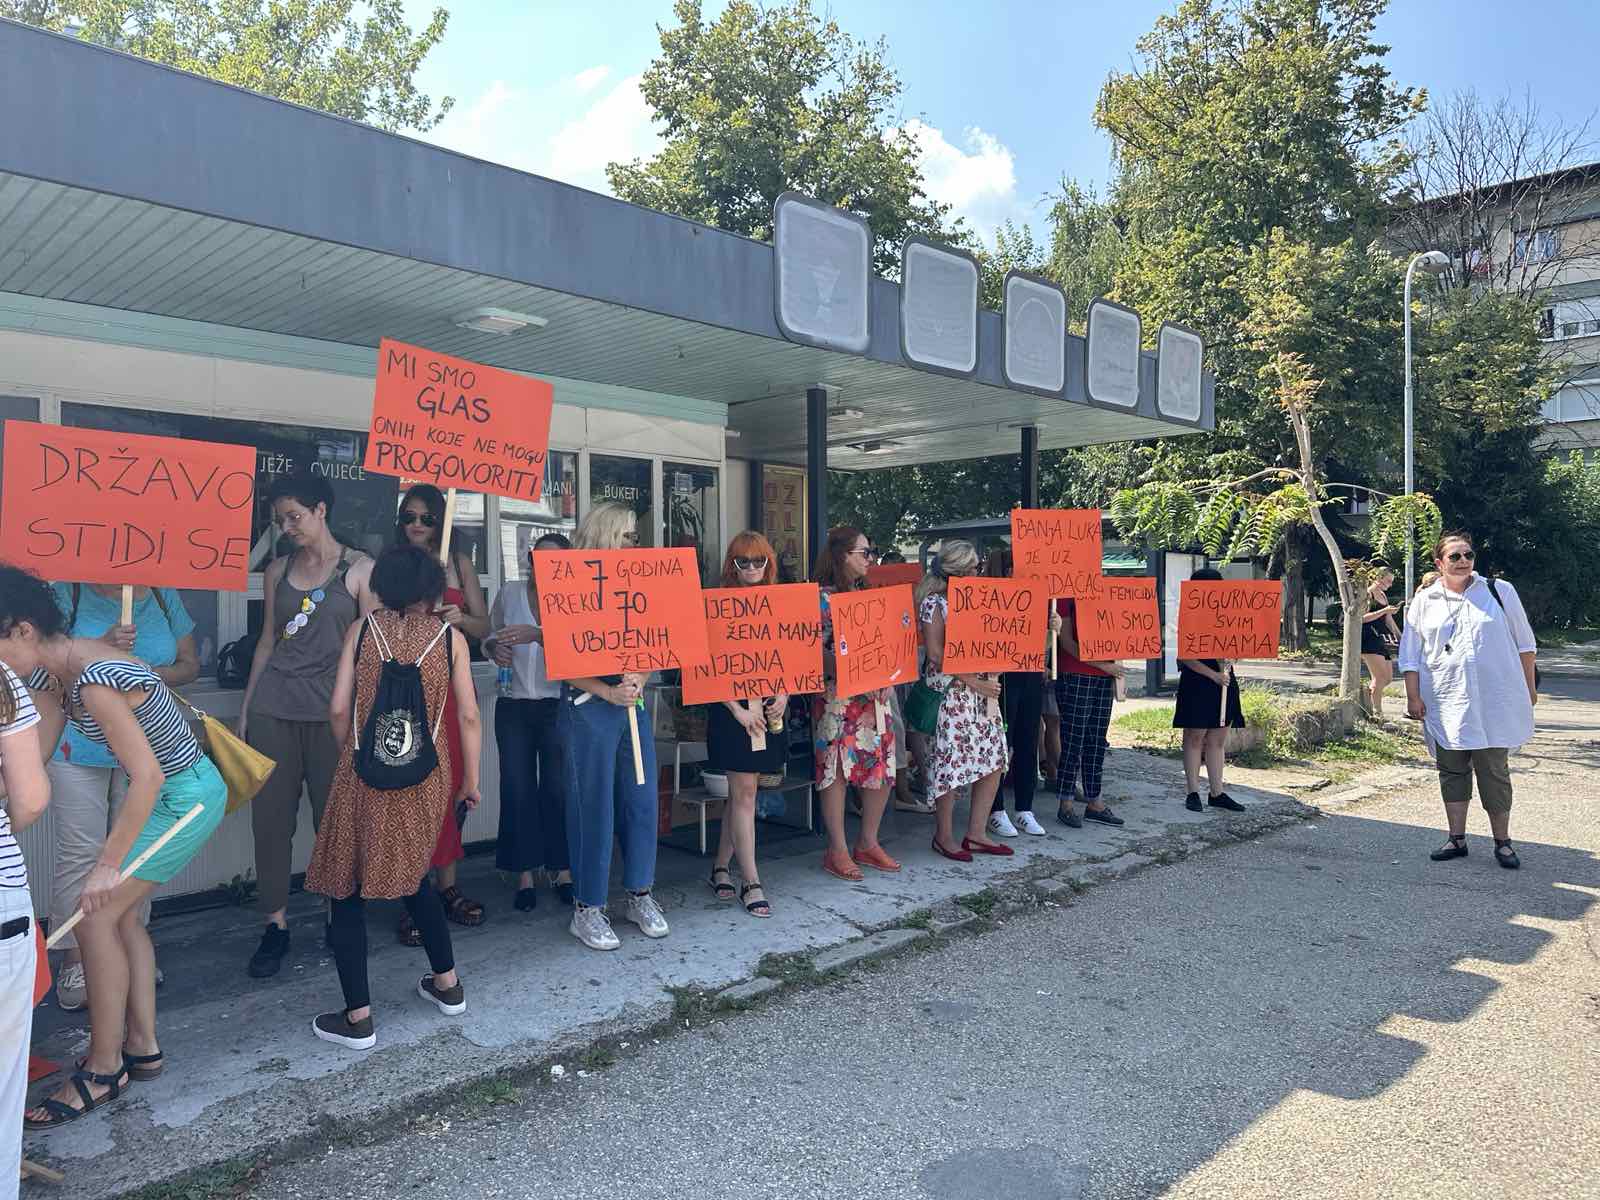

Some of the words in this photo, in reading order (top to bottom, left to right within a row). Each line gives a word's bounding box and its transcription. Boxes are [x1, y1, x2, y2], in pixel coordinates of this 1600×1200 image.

[388, 349, 416, 379] MI
[428, 361, 476, 390] SMO
[416, 386, 491, 423] GLAS
[374, 416, 416, 440] ONIH
[426, 426, 464, 447] KOJE
[473, 437, 496, 455] NE
[503, 443, 544, 467] MOGU
[31, 443, 255, 509] DRŽAVO
[260, 454, 293, 474] JEŽE
[375, 441, 538, 496] PROGOVORITI
[543, 480, 573, 496] MANI
[604, 484, 639, 500] BUKETI
[1016, 518, 1063, 546] BANJA
[1068, 519, 1102, 543] LUKA
[187, 528, 250, 570] SE
[1025, 550, 1041, 565] JE
[1051, 550, 1073, 564] UZ
[551, 560, 575, 580] ZA
[584, 559, 608, 610] 7
[616, 557, 684, 587] GODINA
[543, 591, 602, 616] PREKO
[613, 590, 648, 633] 70
[704, 594, 773, 620] IJEDNA
[953, 585, 1032, 613] DRŽAVO
[1187, 588, 1281, 617] SIGURNOST
[980, 614, 1032, 637] POKAŽI
[1096, 609, 1115, 631] MI
[1121, 610, 1154, 631] SMO
[1216, 614, 1254, 631] SVIM
[571, 627, 670, 654] UBIJENIH
[726, 621, 772, 641] ŽENA
[778, 623, 824, 647] MANJE
[1126, 637, 1162, 656] GLAS
[1185, 633, 1272, 656] ŽENAMA
[616, 650, 682, 672] ŽENA
[946, 641, 965, 659] DA
[971, 640, 1017, 660] NISMO
[733, 675, 789, 698] MRTVA
[794, 670, 826, 692] VIŠE
